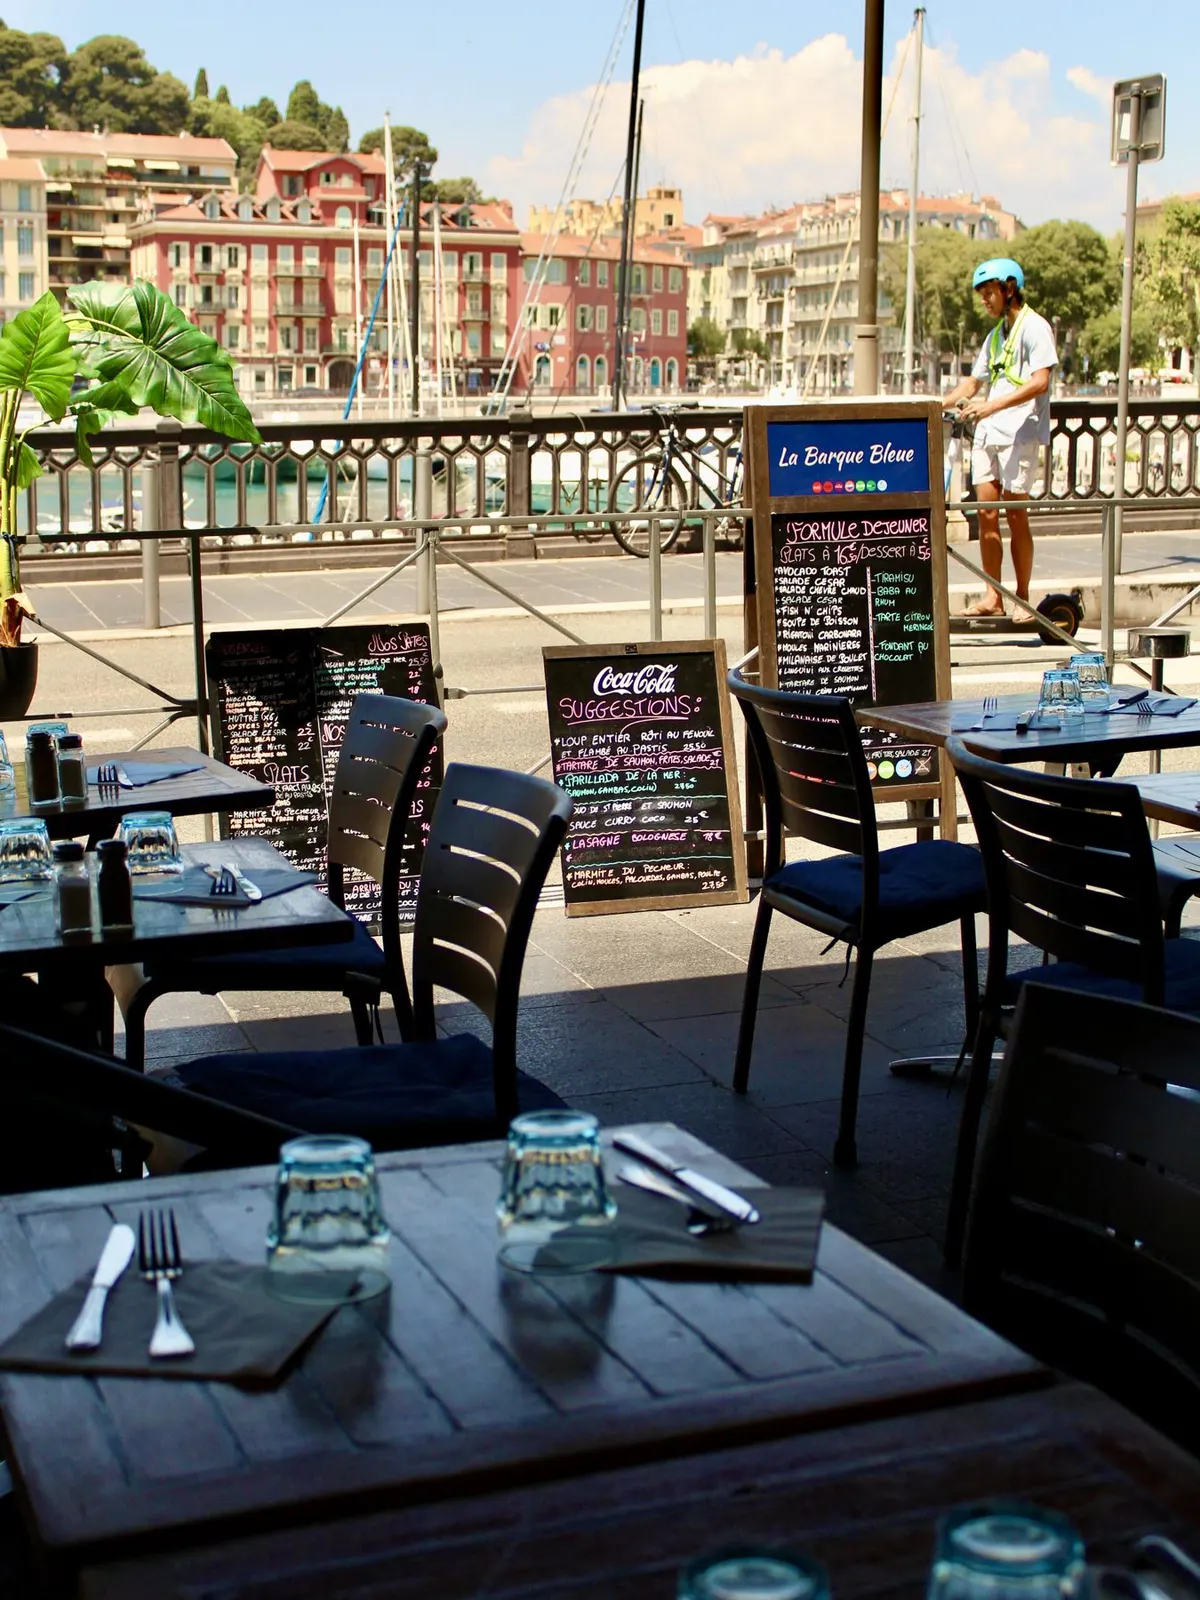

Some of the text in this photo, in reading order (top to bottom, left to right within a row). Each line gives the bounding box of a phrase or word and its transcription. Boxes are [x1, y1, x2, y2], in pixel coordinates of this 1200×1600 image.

[779, 442, 914, 471] La Barque Bleue
[780, 545, 816, 564] PLATS
[778, 566, 851, 576] AVOCADO TOAST
[778, 577, 846, 587] SALADE CESAR
[875, 572, 915, 583] TIRAMISU
[877, 586, 917, 595] BABA AU
[781, 596, 843, 604] SALADE CESAR
[875, 599, 896, 607] RHUM
[781, 606, 799, 615] FISH
[816, 605, 843, 616] CHIPS
[782, 618, 807, 628] SOUPE
[810, 618, 820, 626] DE
[875, 612, 931, 622] TARTE CITRON
[782, 628, 862, 640] RIGATONI CARBONARA
[782, 641, 861, 653] MOULES MARINIERES
[918, 642, 929, 652] AU
[782, 653, 824, 665] MILANAISE
[826, 654, 836, 662] DE
[874, 653, 914, 661] CHOCOLAT
[593, 664, 678, 696] Coca-Cola
[785, 679, 815, 688] TARTARE
[834, 675, 860, 684] SAUMON
[561, 735, 588, 747] LOUP
[592, 733, 631, 746] ENTIER
[641, 730, 662, 741] RÔTI
[667, 731, 680, 739] AU
[561, 743, 668, 758] ET FLAMBÉ AU PASTIS
[561, 760, 599, 771] TARTARE
[607, 757, 620, 767] DE
[263, 762, 310, 784] PLATS
[565, 772, 619, 787] PARILLADA
[625, 771, 639, 780] DE
[647, 771, 658, 780] LA
[640, 801, 651, 809] ET
[657, 800, 693, 809] SAUMON
[569, 819, 597, 831] SAUCE
[604, 815, 637, 827] CURRY
[642, 815, 665, 824] COCO
[572, 834, 621, 850] LASAGNE
[631, 832, 688, 843] BOLOGNESE
[573, 868, 614, 880] MARMITE
[622, 866, 636, 876] DU
